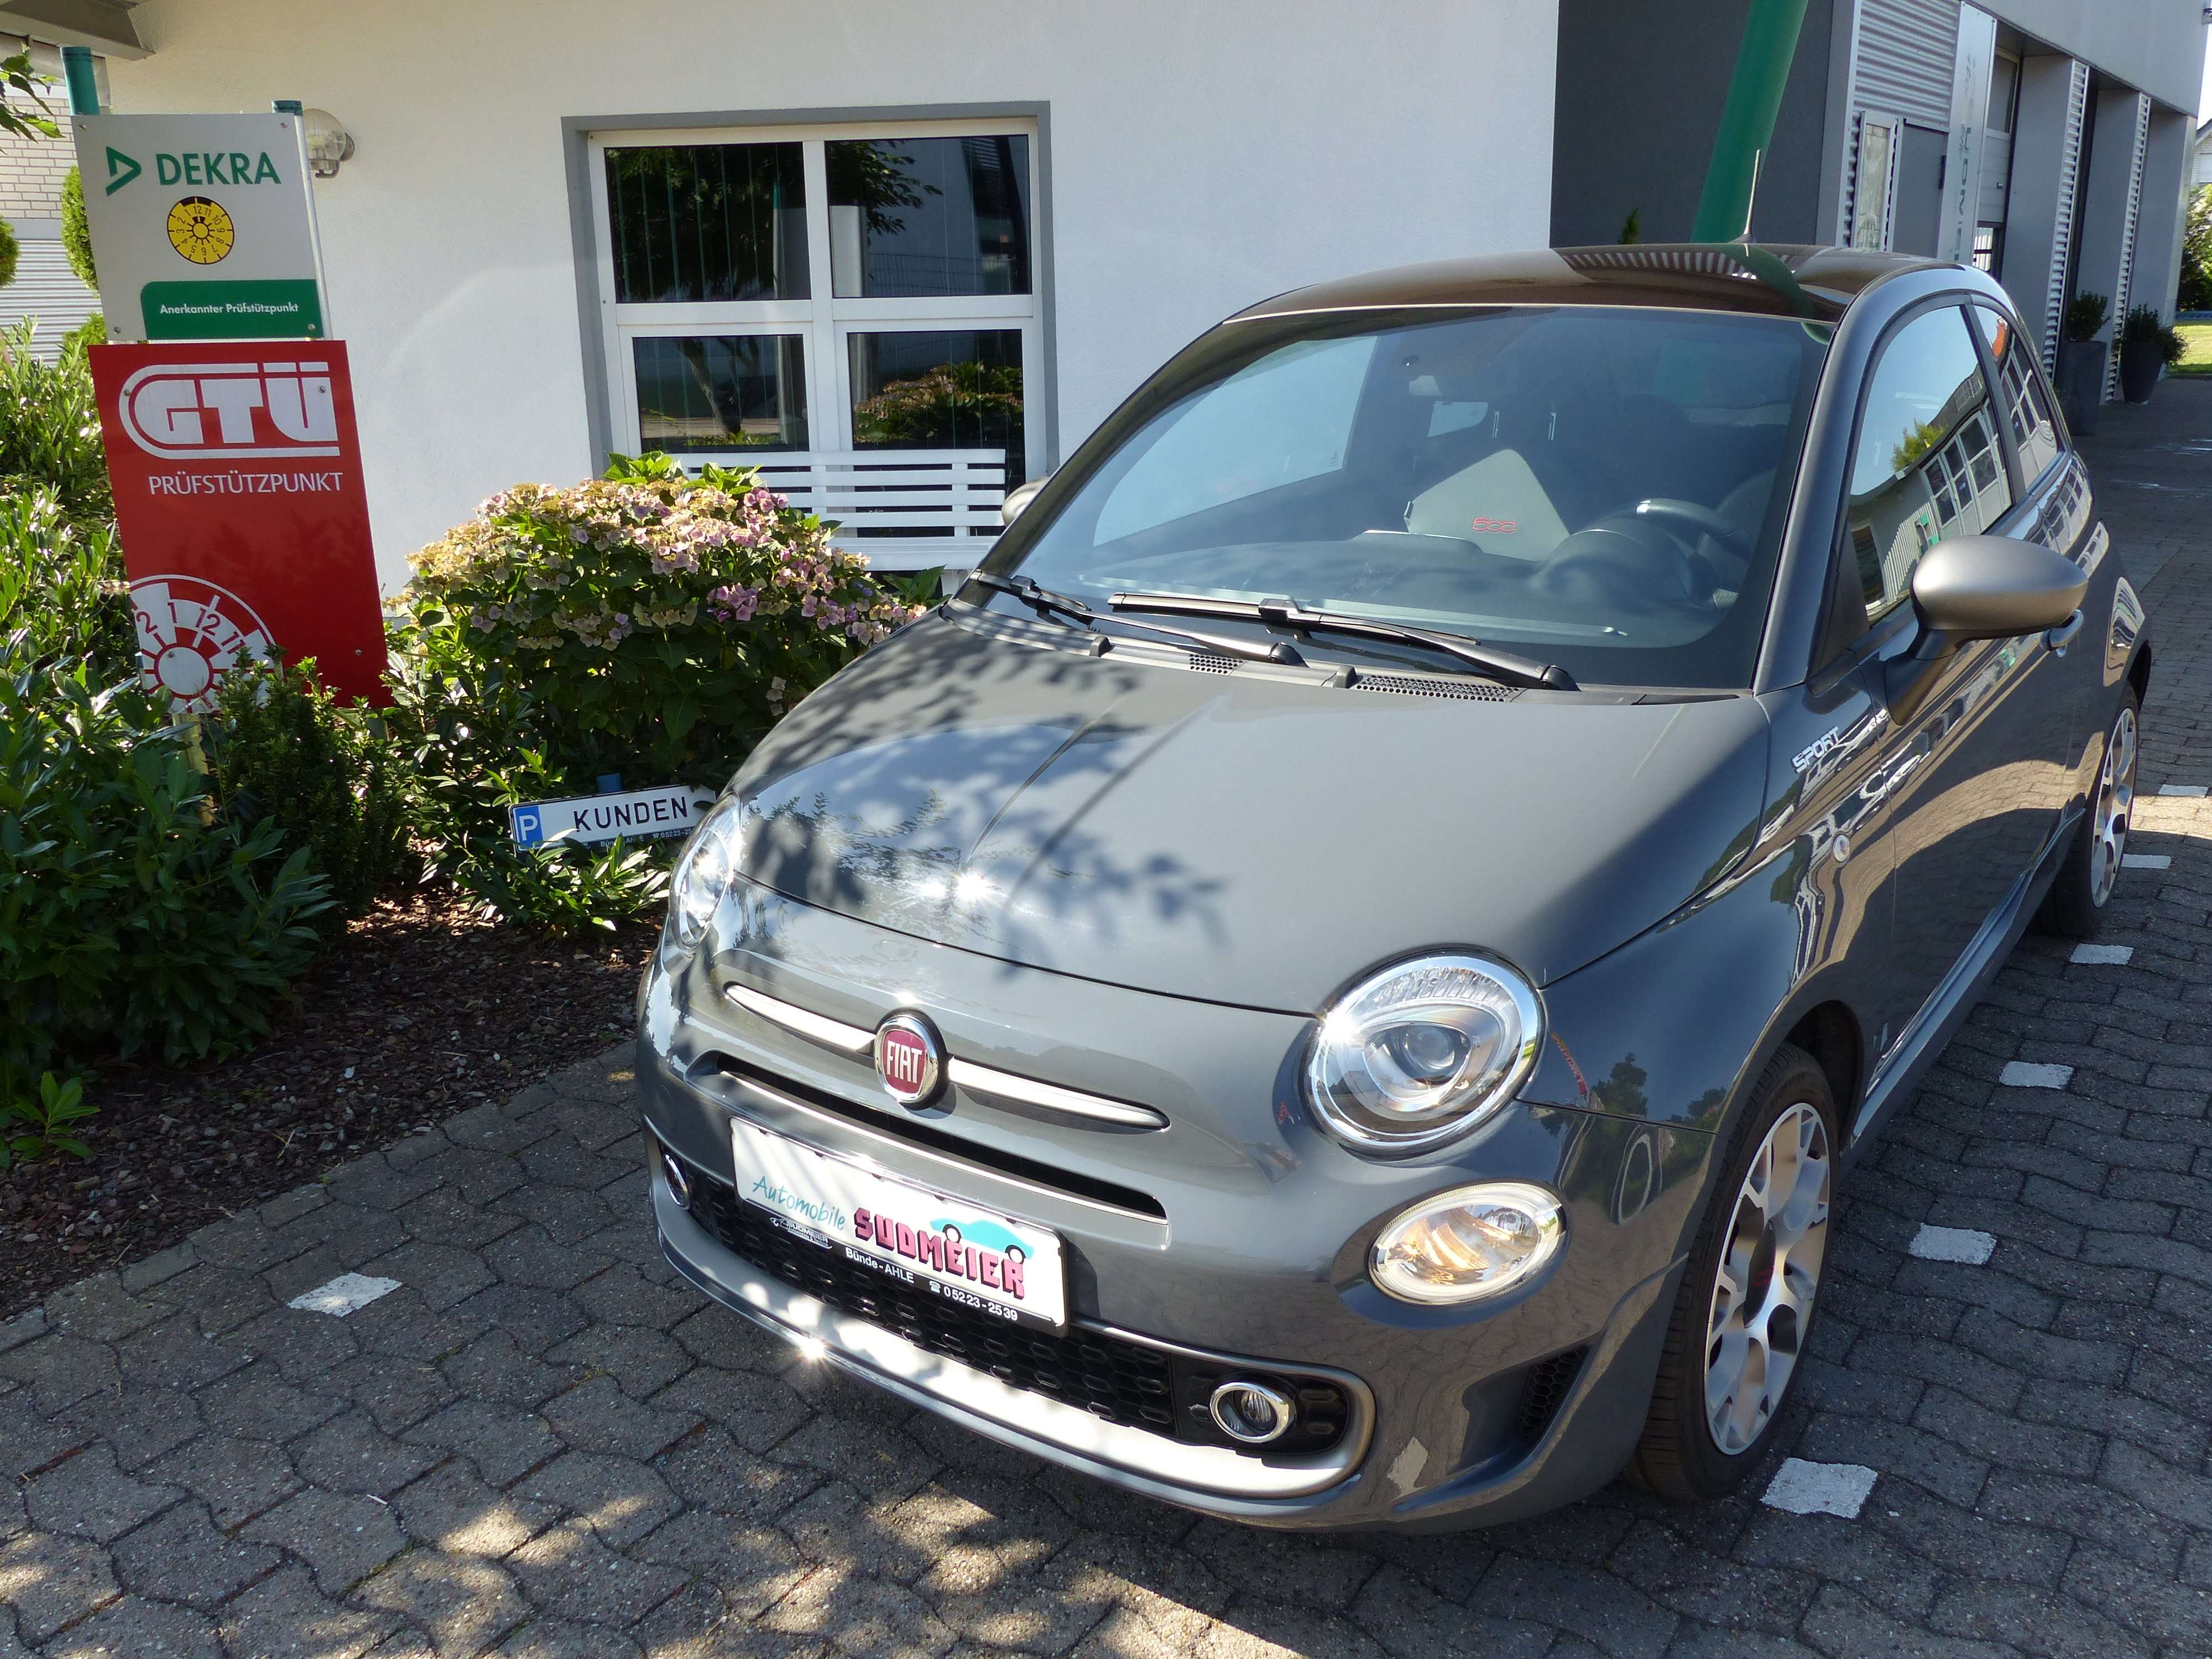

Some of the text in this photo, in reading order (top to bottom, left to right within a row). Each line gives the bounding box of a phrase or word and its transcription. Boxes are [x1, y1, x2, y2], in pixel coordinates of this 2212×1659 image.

[155, 152, 282, 186] DEKRA
[193, 205, 202, 215] 12
[205, 207, 212, 217] 11
[212, 215, 222, 225] 10
[191, 244, 197, 254] 5
[201, 247, 207, 256] 6
[211, 244, 218, 253] 7
[160, 302, 299, 315] Anerkannter Prüfstützpunkt
[125, 362, 340, 452] GTÜ
[148, 470, 343, 495] PRÜFSTÜTZPUNKT
[1472, 518, 1517, 533] 500
[136, 611, 158, 634] 2
[168, 602, 177, 624] 1
[195, 607, 221, 637] 12
[221, 630, 246, 654] 11
[1791, 726, 1839, 774] SPORT
[519, 796, 688, 841] P KUNDEN
[886, 1040, 923, 1084] FIAT
[753, 1175, 846, 1230] Automobile
[853, 1207, 1026, 1300] SUDMEIER
